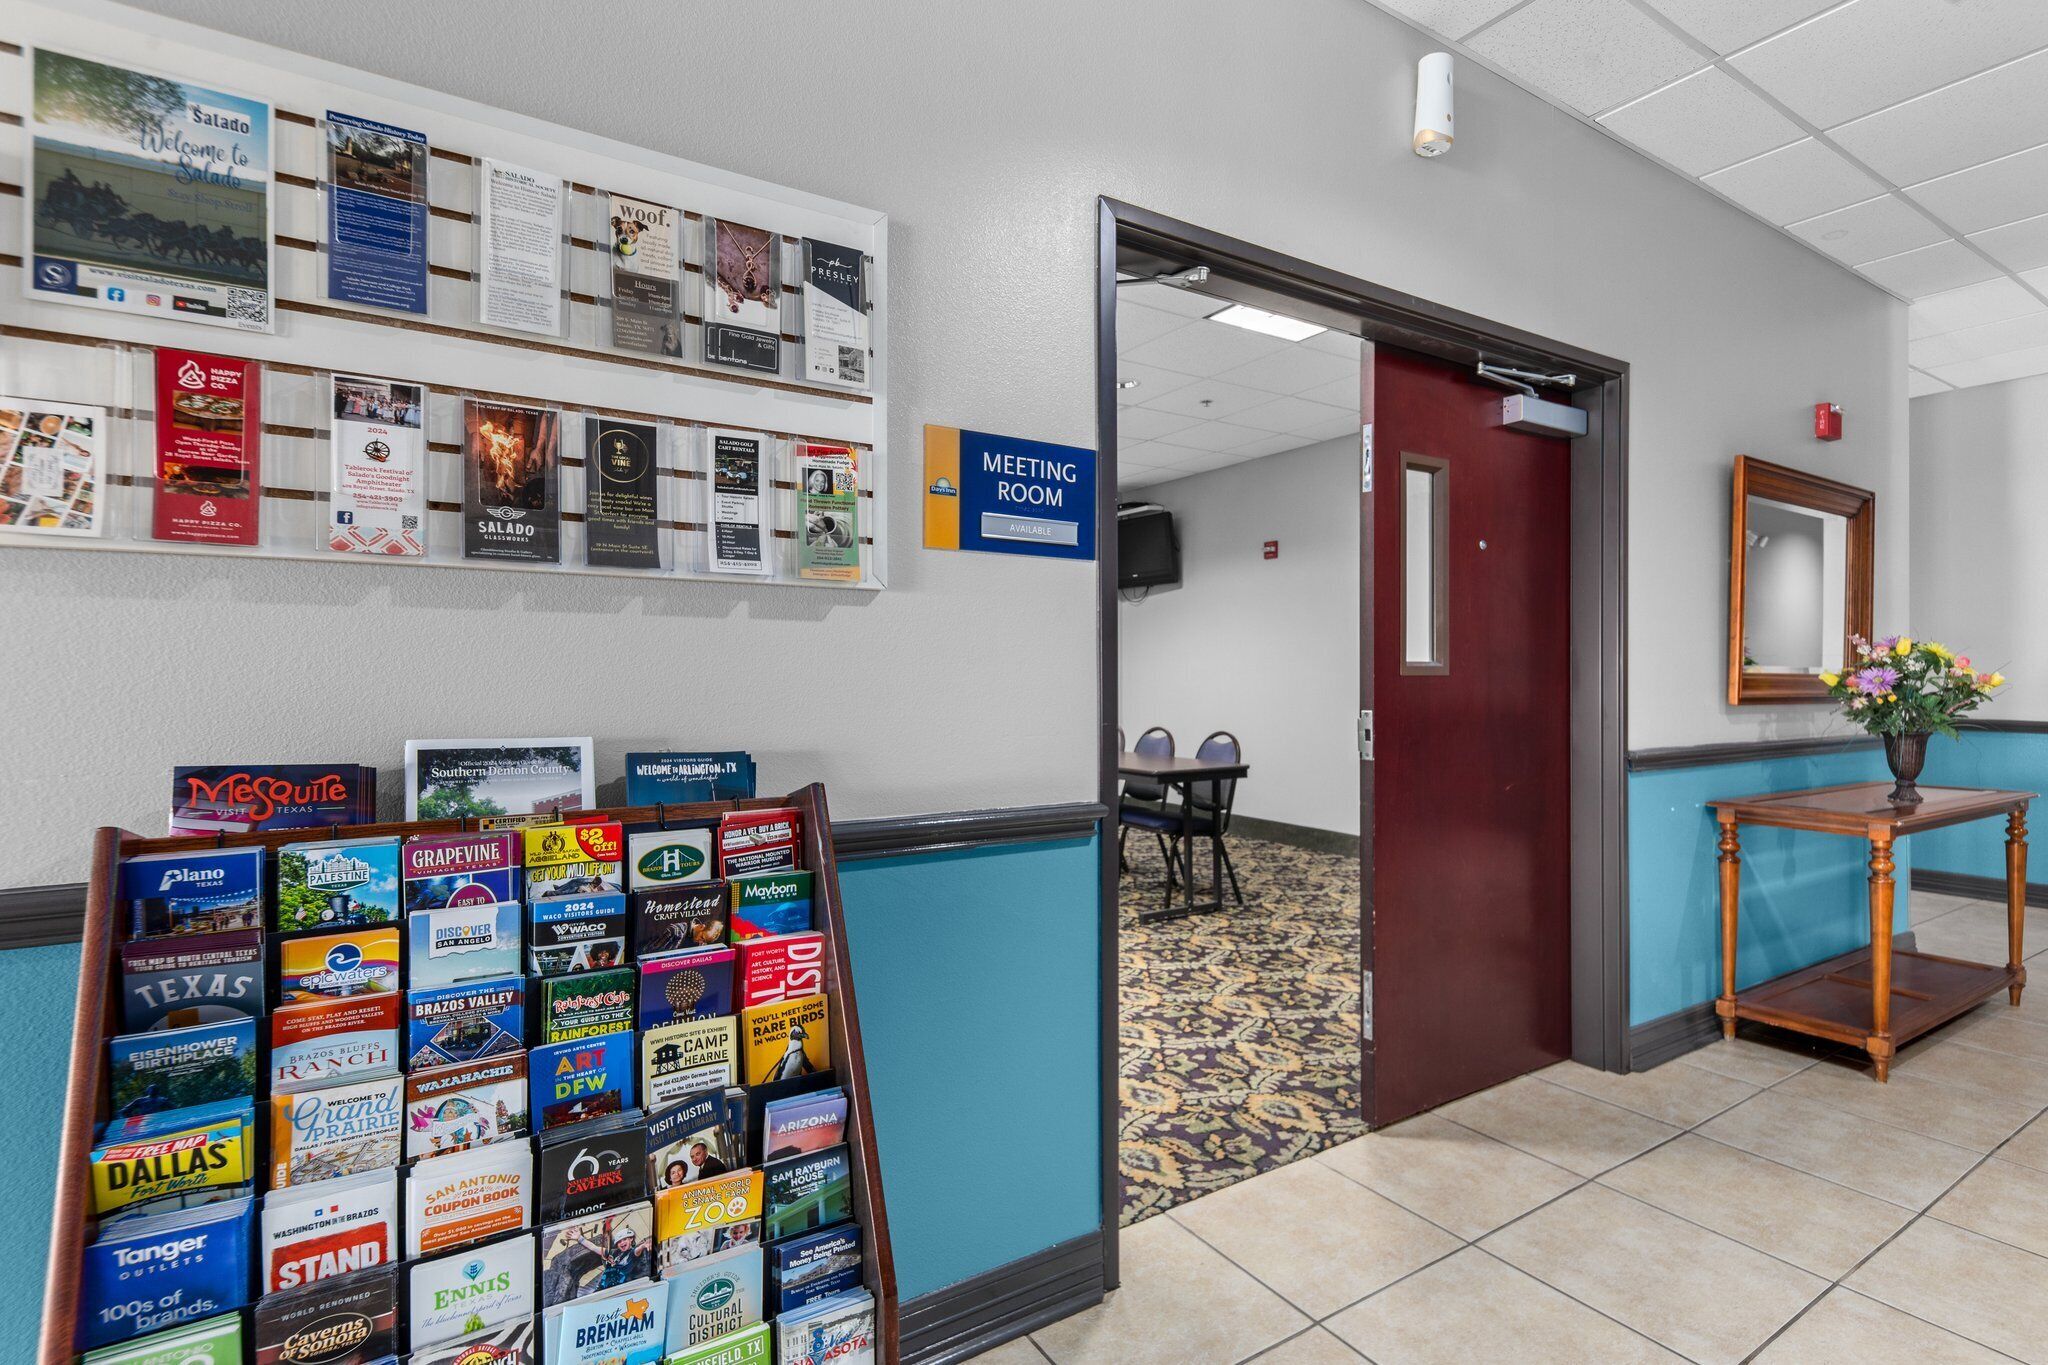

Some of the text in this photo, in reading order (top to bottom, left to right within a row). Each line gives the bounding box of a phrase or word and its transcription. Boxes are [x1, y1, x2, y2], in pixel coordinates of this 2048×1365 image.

[194, 106, 249, 134] Salado
[140, 122, 248, 166] Welcome to
[176, 154, 240, 189] Salado
[620, 205, 670, 227] woof.
[812, 266, 859, 283] PRESLEY
[635, 280, 656, 291] Hours
[756, 336, 775, 344] Jewelry
[210, 368, 242, 377] HAPPY
[210, 375, 238, 384] PIZZA
[368, 427, 387, 435] 2024
[345, 464, 378, 472] Tablerock
[611, 459, 631, 467] VINE
[983, 452, 1076, 483] MEETING
[356, 479, 402, 487] Amphitheater
[376, 474, 409, 482] Goodnight
[998, 481, 1062, 507] ROOM
[479, 521, 534, 536] SALADO
[1010, 524, 1051, 535] AVAILABLE
[431, 765, 569, 778] Southern Denton County
[278, 806, 312, 814] TEXAS
[580, 828, 604, 845] $2
[412, 843, 500, 868] GRAPEVINE
[735, 859, 760, 868] WARRIOR
[762, 855, 783, 863] MUSEUM
[739, 853, 764, 862] NATIONAL
[159, 869, 224, 891] Plano
[310, 870, 368, 885] PALESTINE
[745, 881, 796, 899] Mayborn
[476, 897, 484, 905] TO
[565, 902, 594, 912] 2024
[645, 895, 720, 914] Homestead
[654, 908, 710, 921] CRAFT VILLAGE
[569, 923, 606, 933] WACO
[437, 936, 490, 948] SAN ANGELO
[662, 956, 712, 968] DISCOVER DALLAS
[752, 974, 773, 982] SCIENCE
[134, 974, 253, 1008] TEXAS
[437, 990, 476, 1000] DISCOVER
[416, 991, 513, 1016] BRAZOS VALLEY
[752, 1001, 824, 1025] YOU'LL MEET SOME
[551, 1021, 631, 1042] RAINFOREST
[753, 1010, 824, 1037] RARE BIRDS
[650, 1037, 663, 1045] WWII
[665, 1032, 688, 1041] HISTORIC
[684, 1034, 728, 1053] CAMP
[765, 1032, 789, 1042] WACO.
[129, 1036, 238, 1062] EISENHOWER
[134, 1046, 234, 1070] BIRTHPLACE
[290, 1042, 380, 1064] BRAZOS BLUFFS
[684, 1050, 728, 1066] HEARNE
[278, 1049, 388, 1080] RANCH
[555, 1049, 606, 1076] ART
[416, 1064, 514, 1093] WAXAHACHIE
[555, 1073, 607, 1099] DFW
[328, 1096, 372, 1106] WELCOME
[284, 1086, 398, 1142] Grand
[650, 1101, 712, 1136] VISIT AUSTIN
[778, 1113, 837, 1134] ARIZONA
[312, 1111, 400, 1141] PRAIRIE
[133, 1143, 173, 1158] FREE
[172, 1134, 206, 1149] MAP
[108, 1143, 228, 1190] DALLAS
[608, 1158, 628, 1166] YEARS
[772, 1156, 840, 1184] SAM RAYBURN
[131, 1173, 208, 1198] Fort Worth
[426, 1174, 520, 1204] SAN ANTONIO
[567, 1176, 623, 1195] CAVERNS
[682, 1178, 751, 1200] ANIMAL WORLD
[791, 1170, 824, 1187] HOUSE
[425, 1186, 519, 1216] COUPON BOOK
[462, 1187, 484, 1197] 2024
[684, 1196, 747, 1230] ZOO
[113, 1235, 208, 1266] Tanger
[789, 1241, 855, 1269] Money Being Printed
[800, 1238, 845, 1258] See America's
[119, 1254, 204, 1281] OUTLETS
[279, 1241, 380, 1290] STAND
[434, 1271, 510, 1310] ENNIS
[100, 1289, 182, 1323] 100s of
[136, 1298, 218, 1330] brands.
[281, 1292, 370, 1321] WORLD RENOWNED
[596, 1307, 621, 1324] Visit
[690, 1299, 742, 1330] CULTURAL
[284, 1318, 364, 1349] Caverns
[576, 1311, 654, 1348] BRENHAM
[690, 1316, 742, 1345] DISTRICT
[747, 1339, 760, 1355] TX
